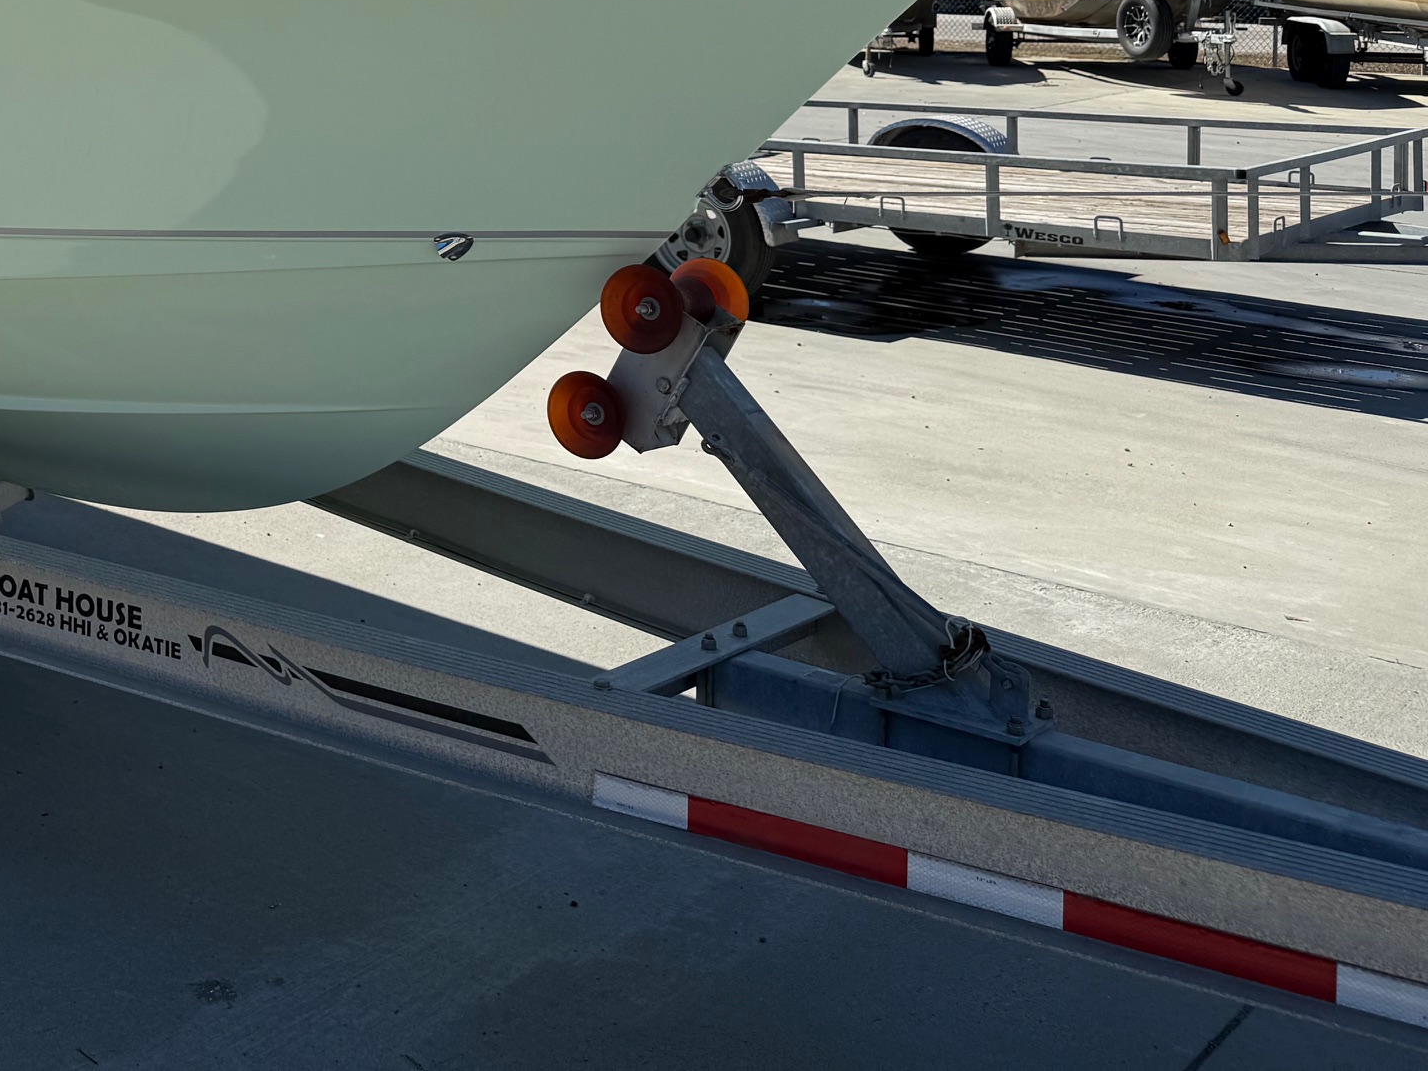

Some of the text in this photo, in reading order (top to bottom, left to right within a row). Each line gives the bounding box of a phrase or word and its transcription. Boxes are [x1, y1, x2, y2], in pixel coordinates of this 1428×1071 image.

[55, 587, 142, 631] HOUSE
[60, 614, 91, 637] HHI
[96, 624, 109, 642] &
[113, 628, 181, 660] OKATIE
